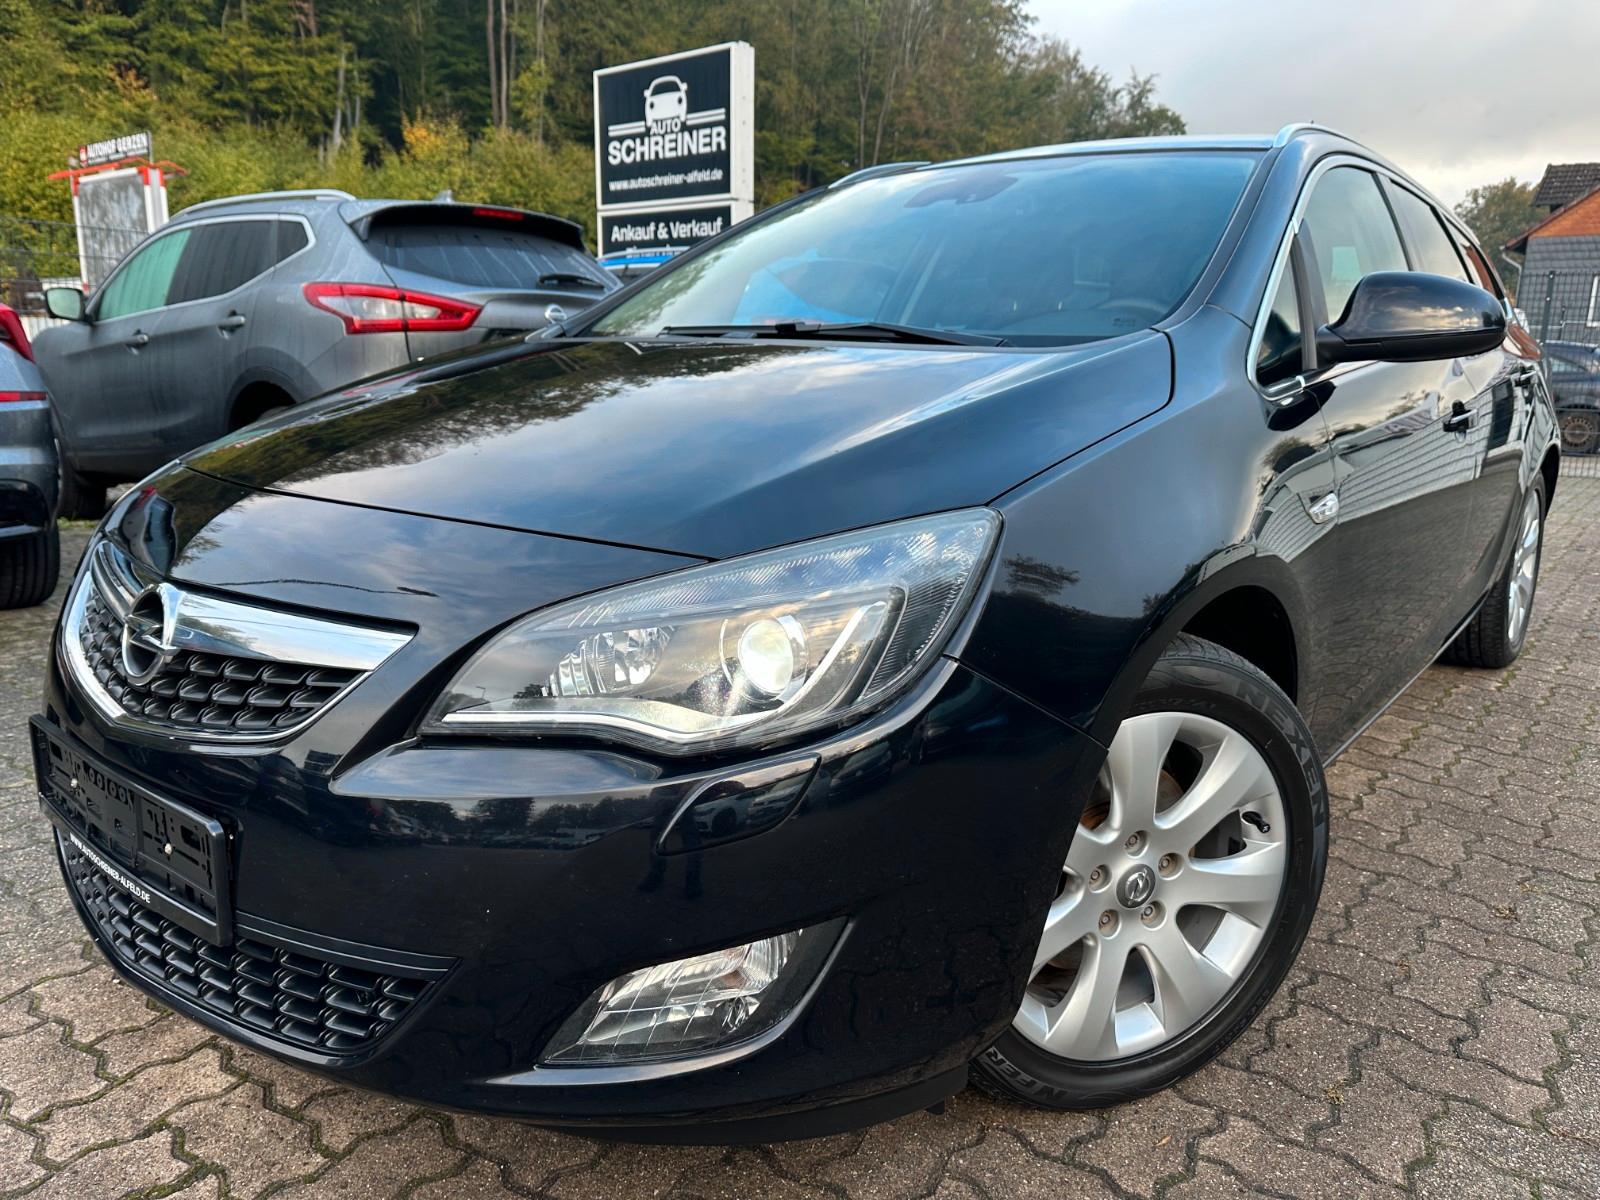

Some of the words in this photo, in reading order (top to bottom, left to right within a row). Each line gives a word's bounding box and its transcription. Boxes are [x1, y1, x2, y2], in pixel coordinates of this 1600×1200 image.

[650, 119, 681, 135] AUTO
[608, 126, 726, 165] SCHREINER
[608, 168, 723, 191] www.autoschreiner-alfeld.de
[611, 222, 657, 242] Ankauf
[657, 222, 669, 239] &
[669, 217, 723, 239] Verkauf
